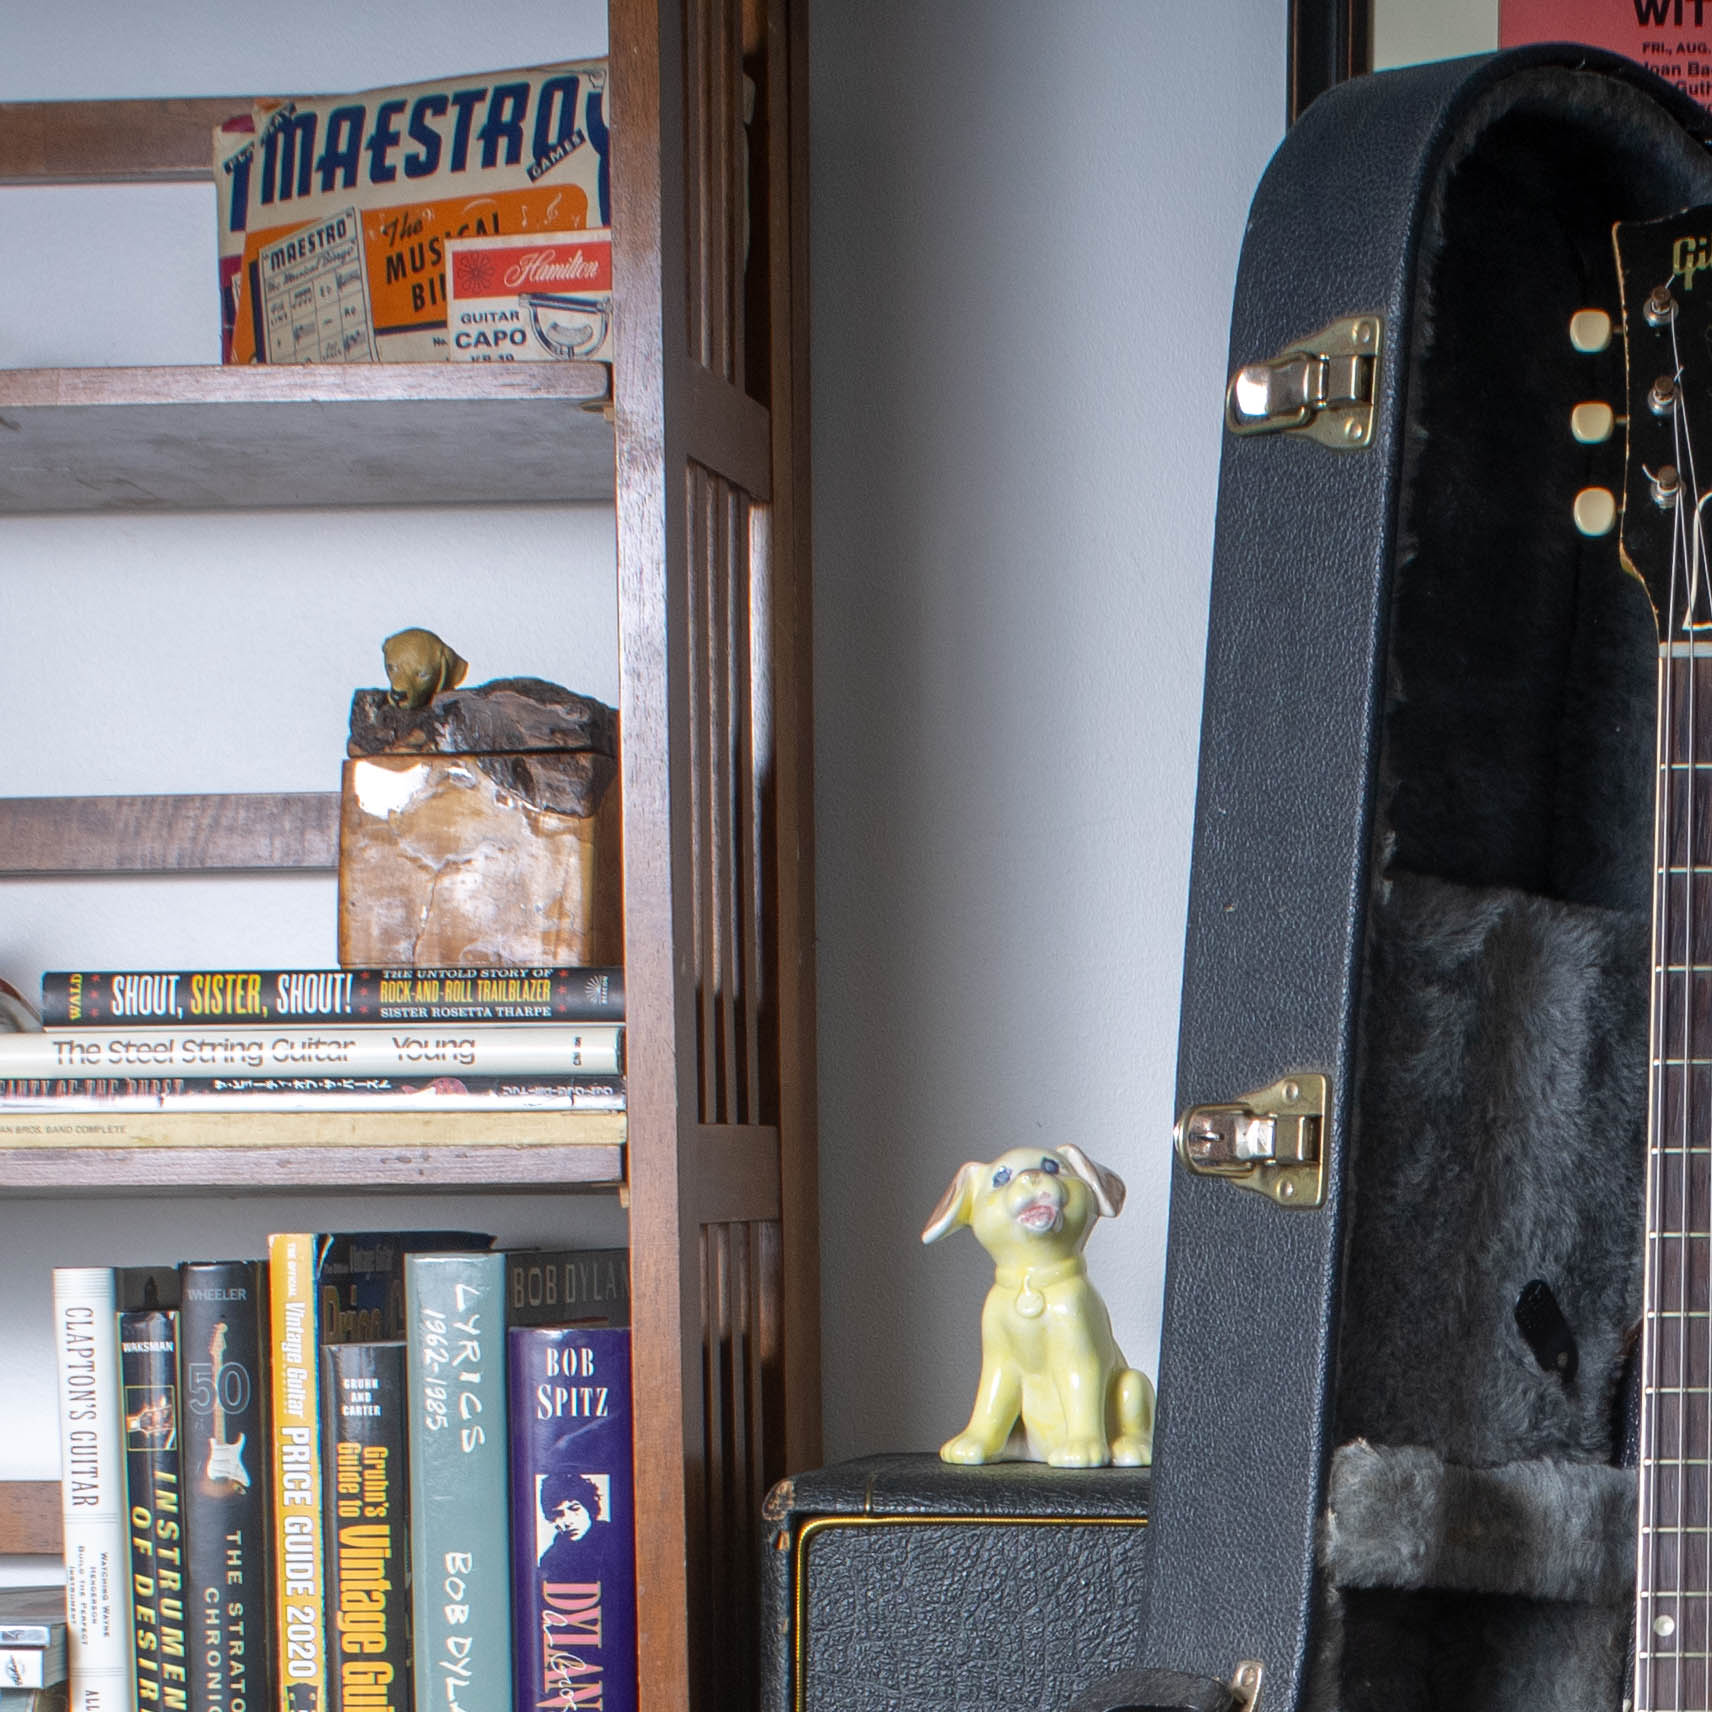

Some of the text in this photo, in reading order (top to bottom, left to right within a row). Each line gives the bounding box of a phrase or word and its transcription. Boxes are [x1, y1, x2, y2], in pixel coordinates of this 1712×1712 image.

[1676, 42, 1711, 55] AUG.
[261, 75, 581, 206] MAESTRO
[381, 211, 424, 248] The
[504, 249, 600, 288] Hamilton
[455, 327, 527, 349] CAPO
[461, 310, 520, 324] GUITAR
[69, 973, 83, 1020] WALD
[111, 973, 353, 1020] SHOUT, SISTER, SHOUT!
[380, 979, 552, 1003] ROCK-AND-ROLL TRAILBLAZER
[383, 968, 554, 979] THE UNTOLD STORY OF
[381, 1006, 552, 1019] SISTER ROSETTA THARPE
[53, 1037, 476, 1067] The Steel String Guitar Young
[188, 1288, 248, 1301] WHEELER
[512, 1264, 558, 1309] BOB
[122, 1341, 175, 1353] WAKSMAN
[281, 1302, 308, 1418] Vintage Guitar
[422, 1308, 450, 1431] 1962-1985
[452, 1283, 486, 1454] LYRICS
[545, 1347, 595, 1377] BOB
[64, 1306, 100, 1507] CLAPTON'S GUITAR
[188, 1361, 251, 1416] 50
[342, 1405, 381, 1417] CARTER
[536, 1384, 608, 1420] SPITZ
[336, 1442, 361, 1494] Guide
[363, 1446, 389, 1518] Gruhn's
[132, 1506, 153, 1557] OF
[281, 1427, 317, 1679] PRICE GUIDE 2020
[225, 1530, 244, 1585] THE
[336, 1523, 392, 1654] Vintage
[443, 1551, 473, 1625] BOB
[535, 1580, 604, 1712] DYLAN
